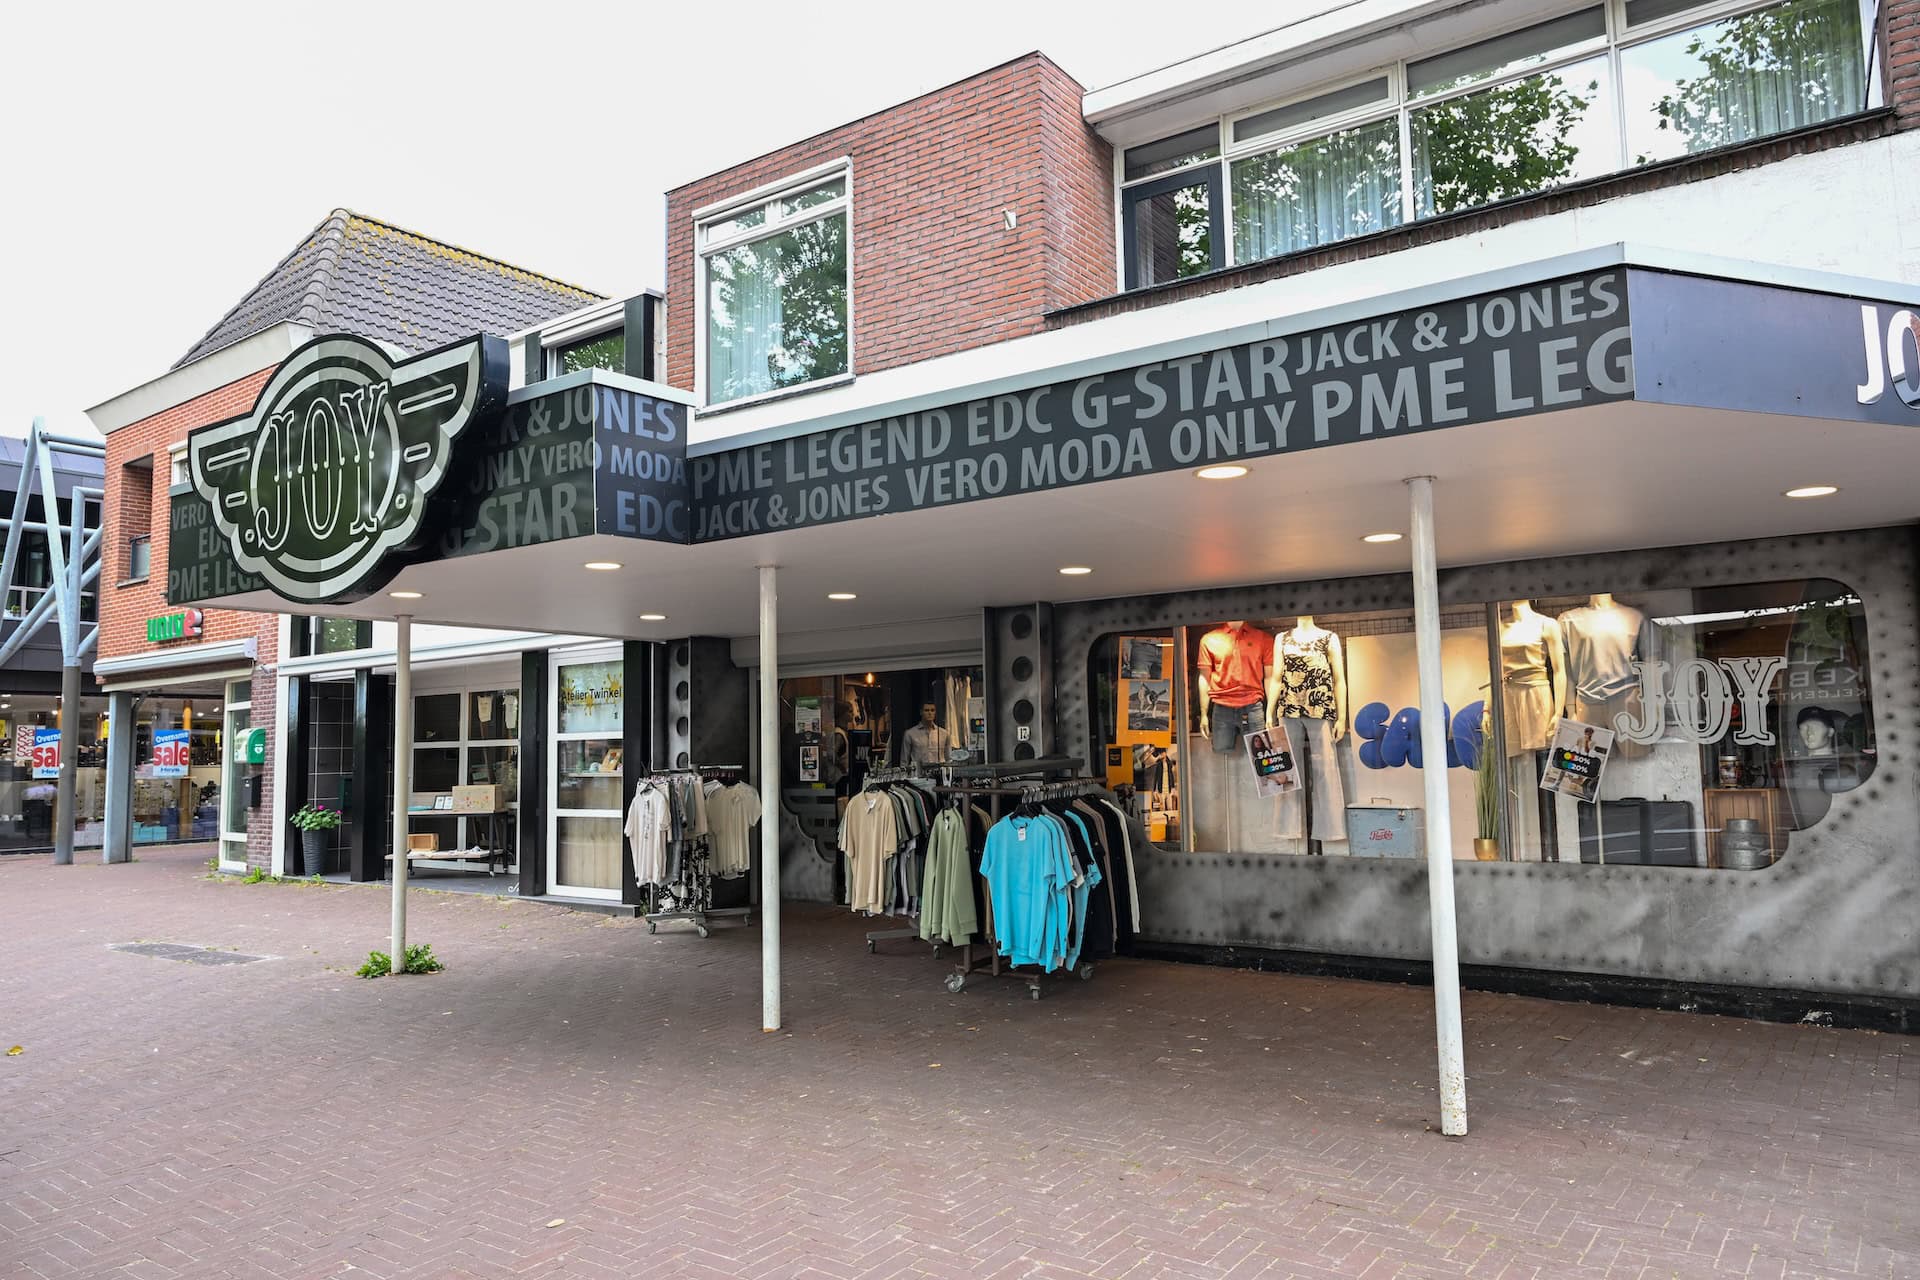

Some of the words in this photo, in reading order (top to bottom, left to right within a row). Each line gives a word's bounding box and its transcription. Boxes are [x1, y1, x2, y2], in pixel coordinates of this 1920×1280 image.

[1296, 319, 1400, 376] JACK
[1412, 311, 1449, 352] &
[1459, 274, 1620, 345] JONES
[694, 444, 774, 499] PME
[785, 408, 951, 483] LEGEND
[967, 388, 1052, 447] EDC
[1072, 338, 1292, 429] G-STAR
[1312, 356, 1468, 442] PME
[255, 381, 389, 551] JOY
[610, 444, 688, 486] MODA
[696, 498, 761, 539] JACK
[766, 494, 789, 527] &
[795, 474, 890, 524] JONES
[905, 452, 1007, 506] VERO
[1020, 427, 1153, 489] MODA
[1170, 399, 1297, 464] ONLY
[172, 502, 207, 531] VERO
[616, 490, 687, 538] EDC
[169, 563, 209, 603] PME
[1613, 656, 1787, 746] JOY
[33, 741, 61, 768] sal
[153, 741, 189, 766] sale
